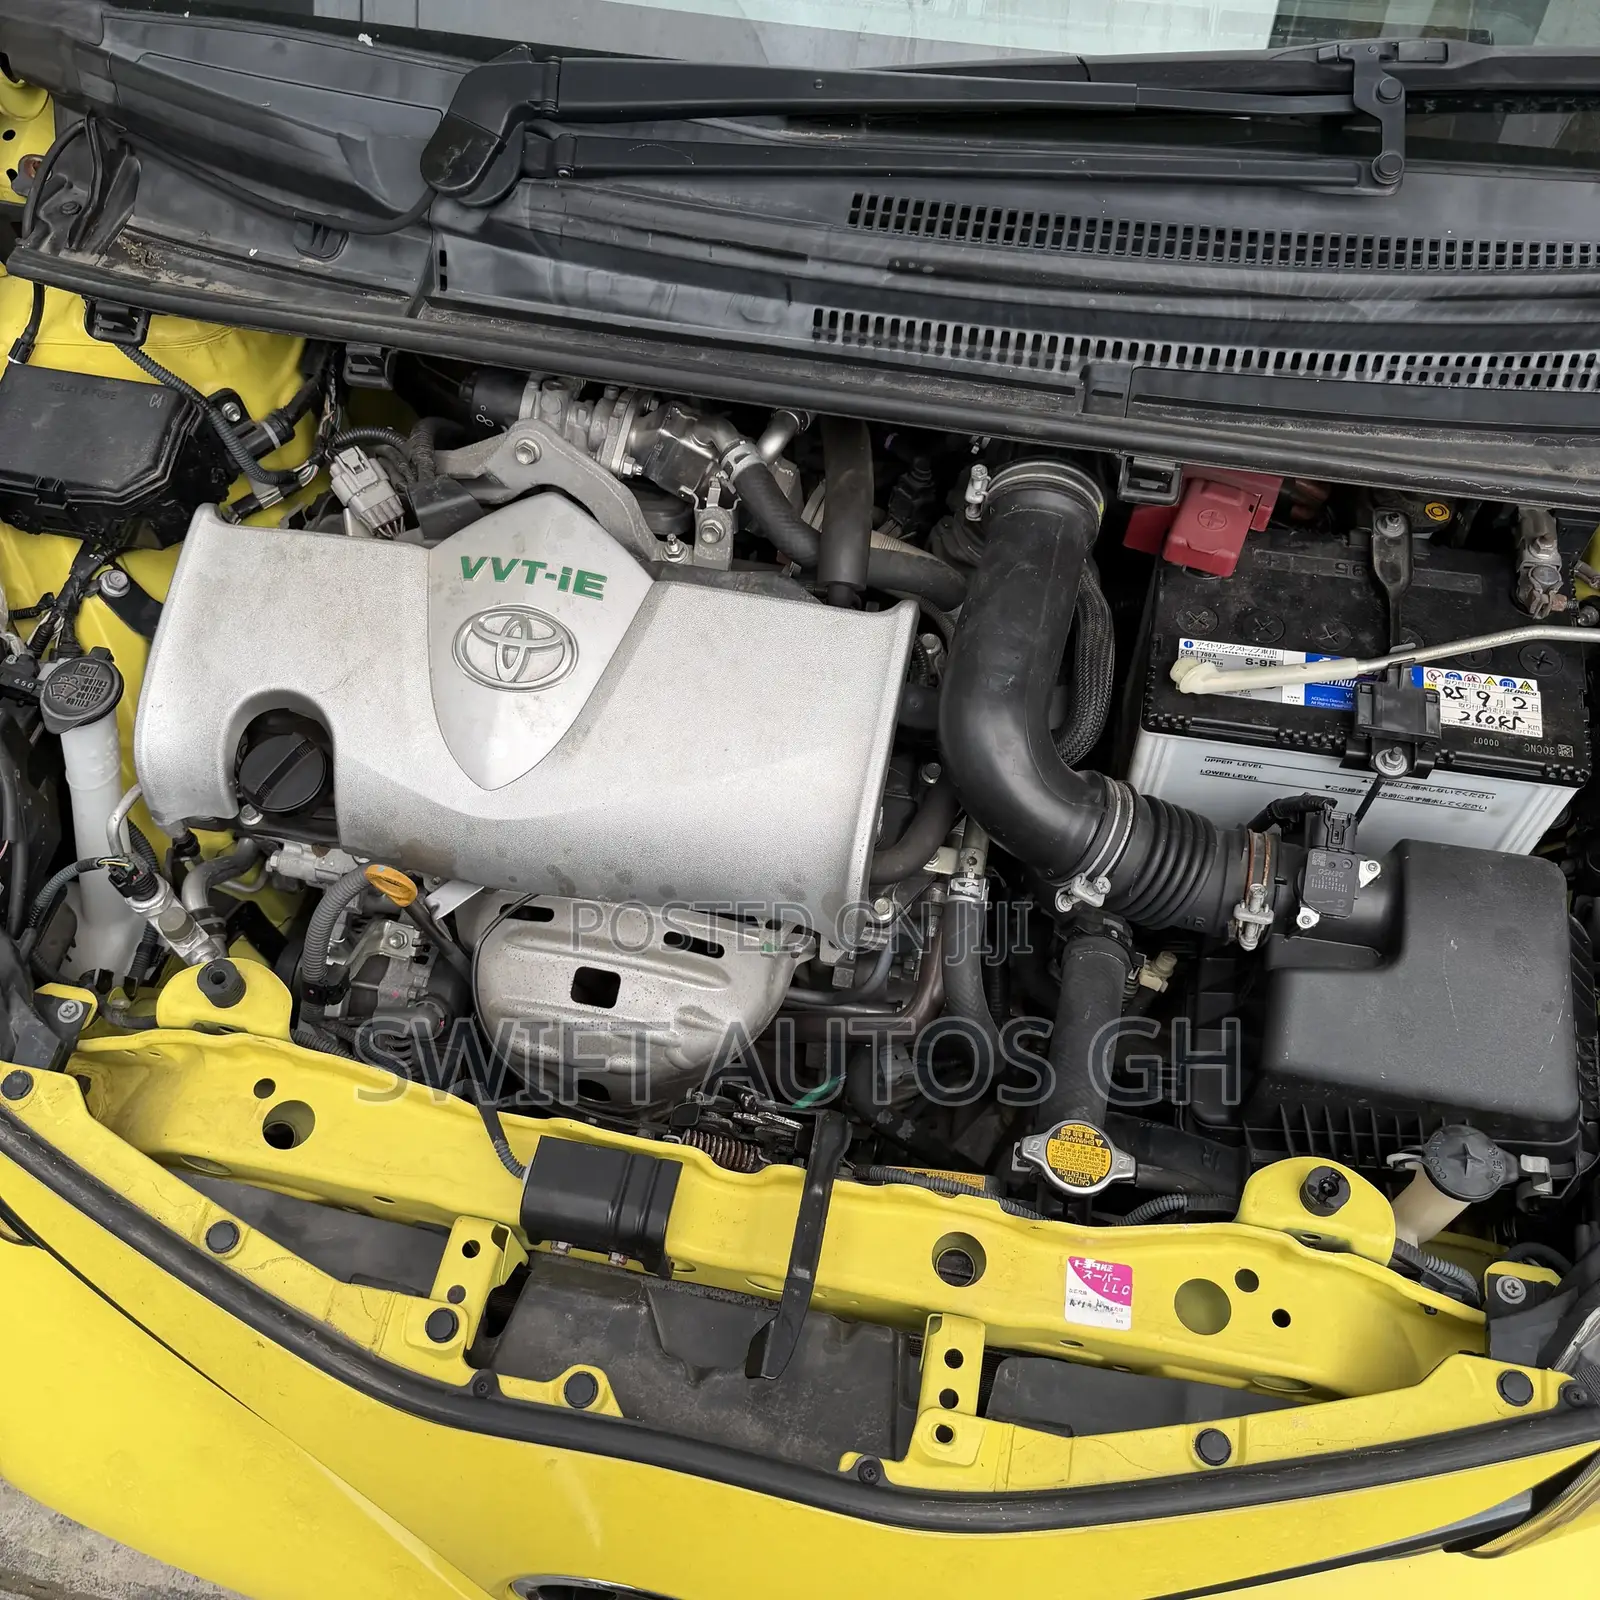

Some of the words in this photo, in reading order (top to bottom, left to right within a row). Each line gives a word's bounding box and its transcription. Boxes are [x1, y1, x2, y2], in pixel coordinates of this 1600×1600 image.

[460, 555, 608, 601] VVT-iE
[1512, 696, 1528, 710] 2
[1204, 757, 1233, 765] UPPER
[1237, 761, 1264, 770] LEVEL
[1200, 769, 1231, 778] LOWER
[1232, 773, 1259, 781] LEVEL
[1063, 1175, 1091, 1187] CAUTION
[1082, 1269, 1122, 1283] スーパー
